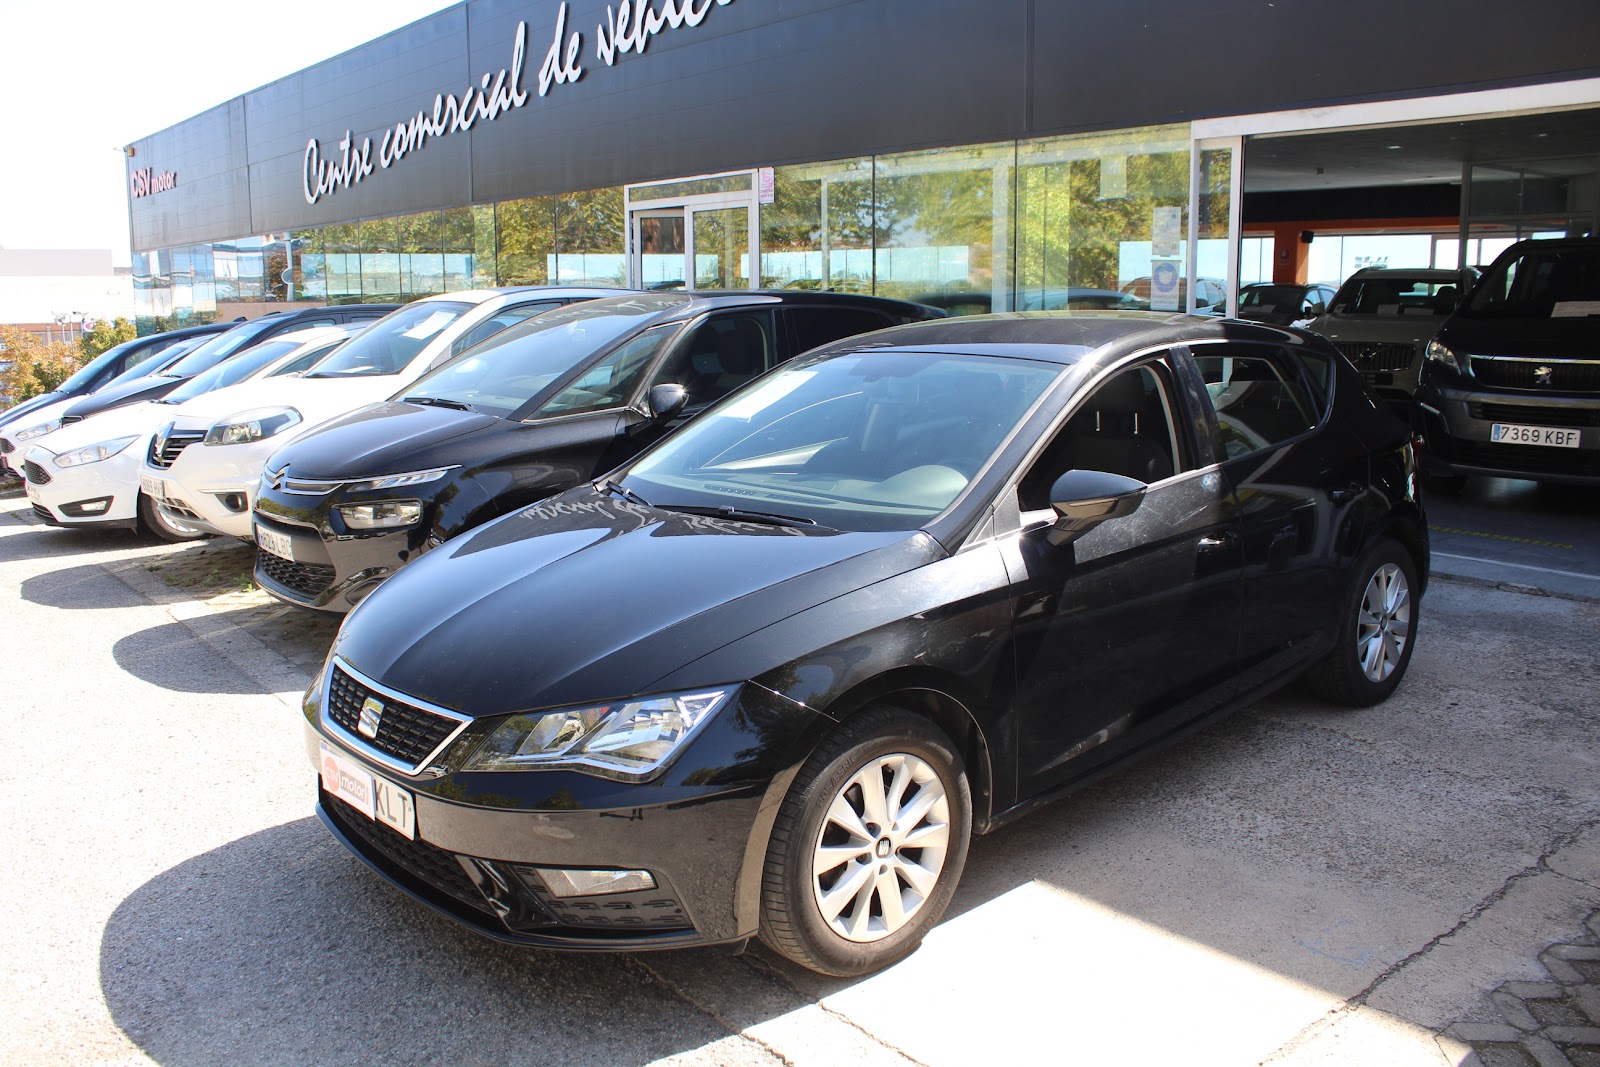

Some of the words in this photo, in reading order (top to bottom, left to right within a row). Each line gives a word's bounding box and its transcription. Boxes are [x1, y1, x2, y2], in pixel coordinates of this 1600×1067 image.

[303, 130, 373, 204] Centre
[380, 20, 527, 169] comercial
[538, 1, 582, 97] de
[130, 167, 151, 199] CSV
[151, 169, 176, 194] motor
[1501, 426, 1541, 443] 7369
[1544, 430, 1577, 446] KBF
[341, 774, 366, 797] motor
[374, 779, 408, 829] KLT
